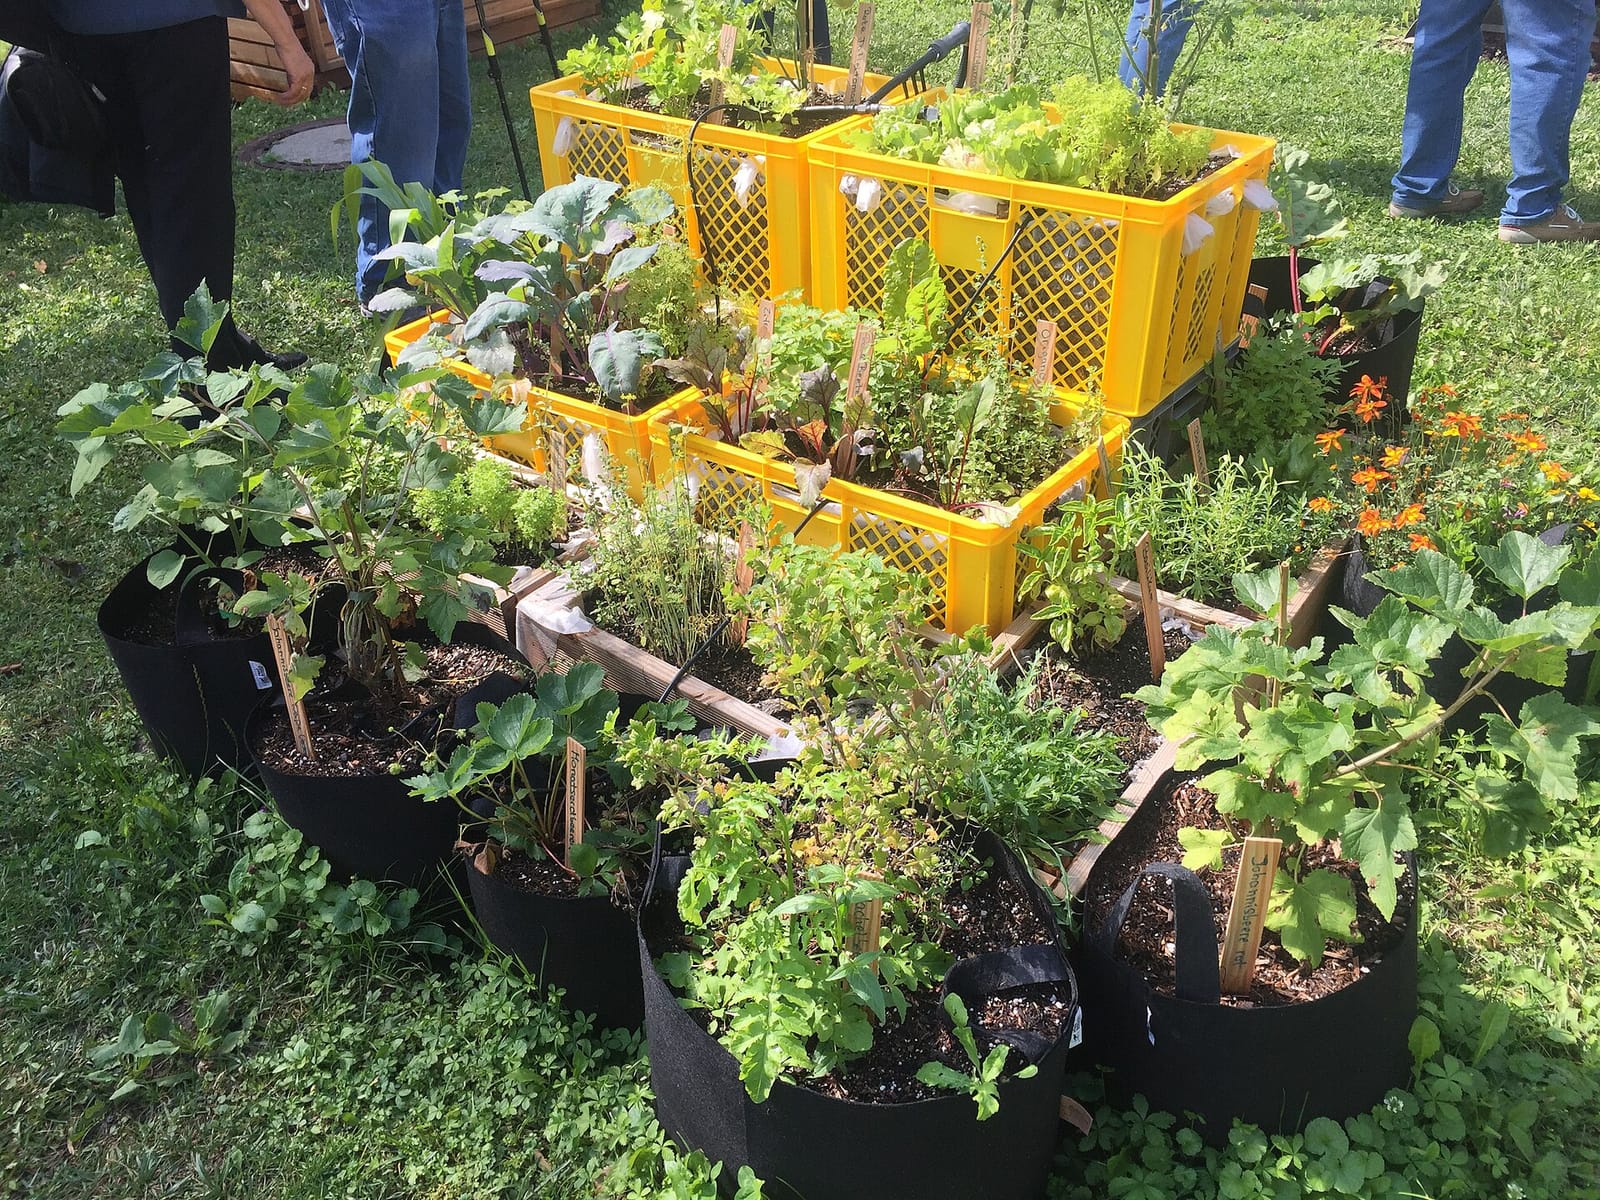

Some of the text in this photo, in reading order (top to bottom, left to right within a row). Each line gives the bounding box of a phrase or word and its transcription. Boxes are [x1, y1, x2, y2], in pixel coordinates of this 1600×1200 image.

[1037, 329, 1052, 382] Oregano
[1142, 541, 1154, 603] Basilikum
[1232, 854, 1269, 969] Johannisbeere rot
